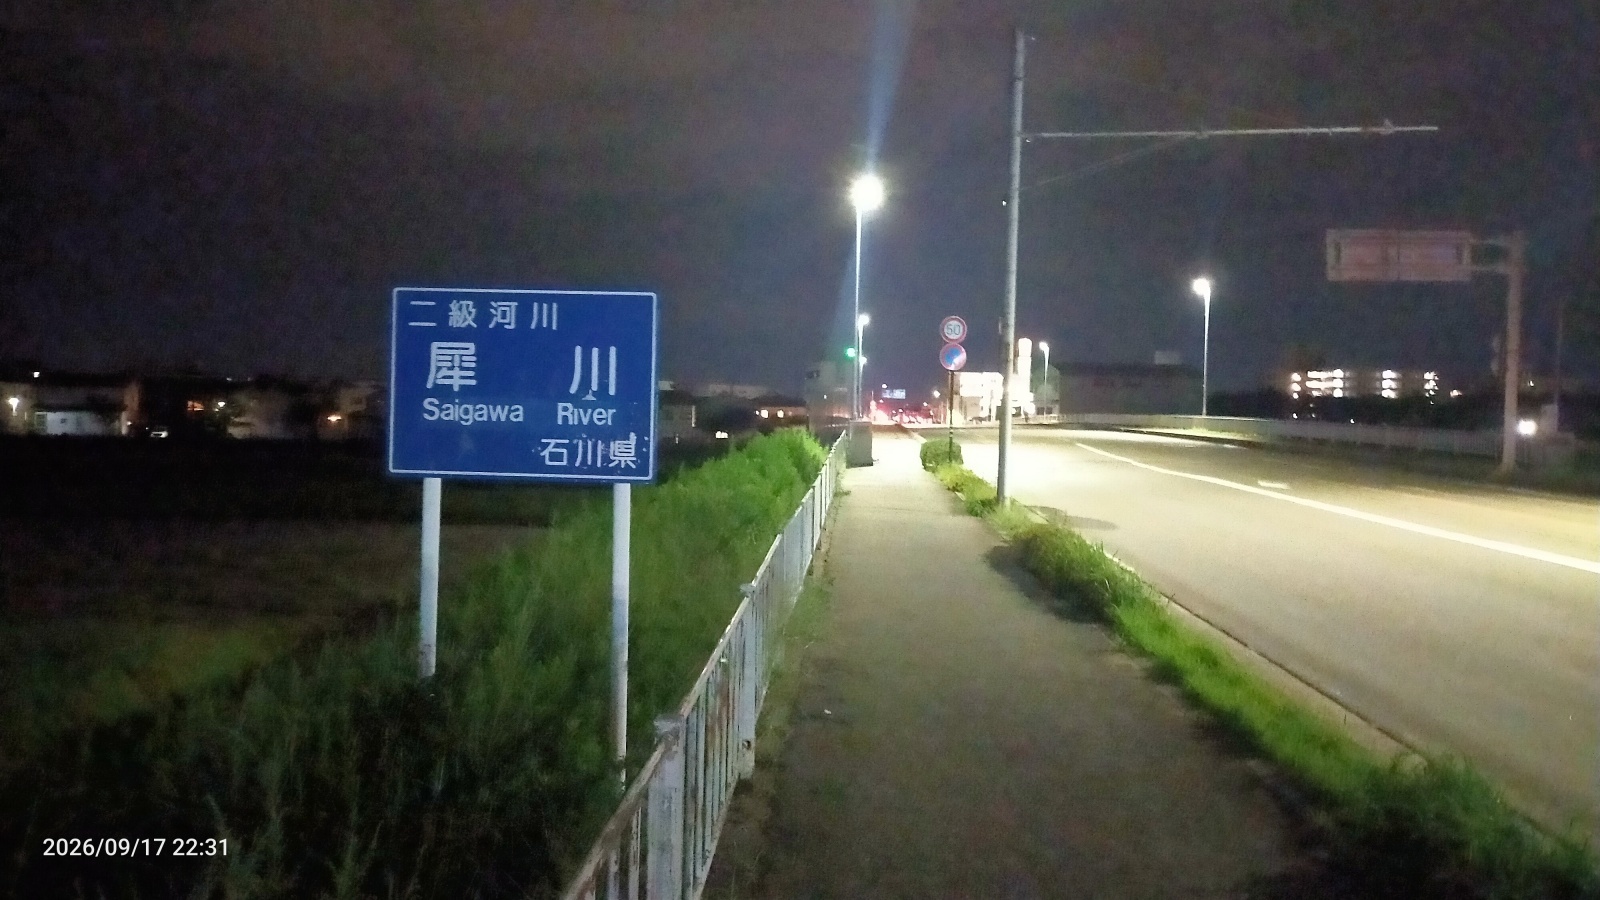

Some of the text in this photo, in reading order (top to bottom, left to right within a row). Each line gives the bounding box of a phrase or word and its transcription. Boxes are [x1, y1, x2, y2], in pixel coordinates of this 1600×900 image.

[408, 300, 558, 330] 二級河川
[946, 324, 961, 335] 50
[422, 397, 617, 426] Saigawa River
[539, 437, 637, 469] 石川県
